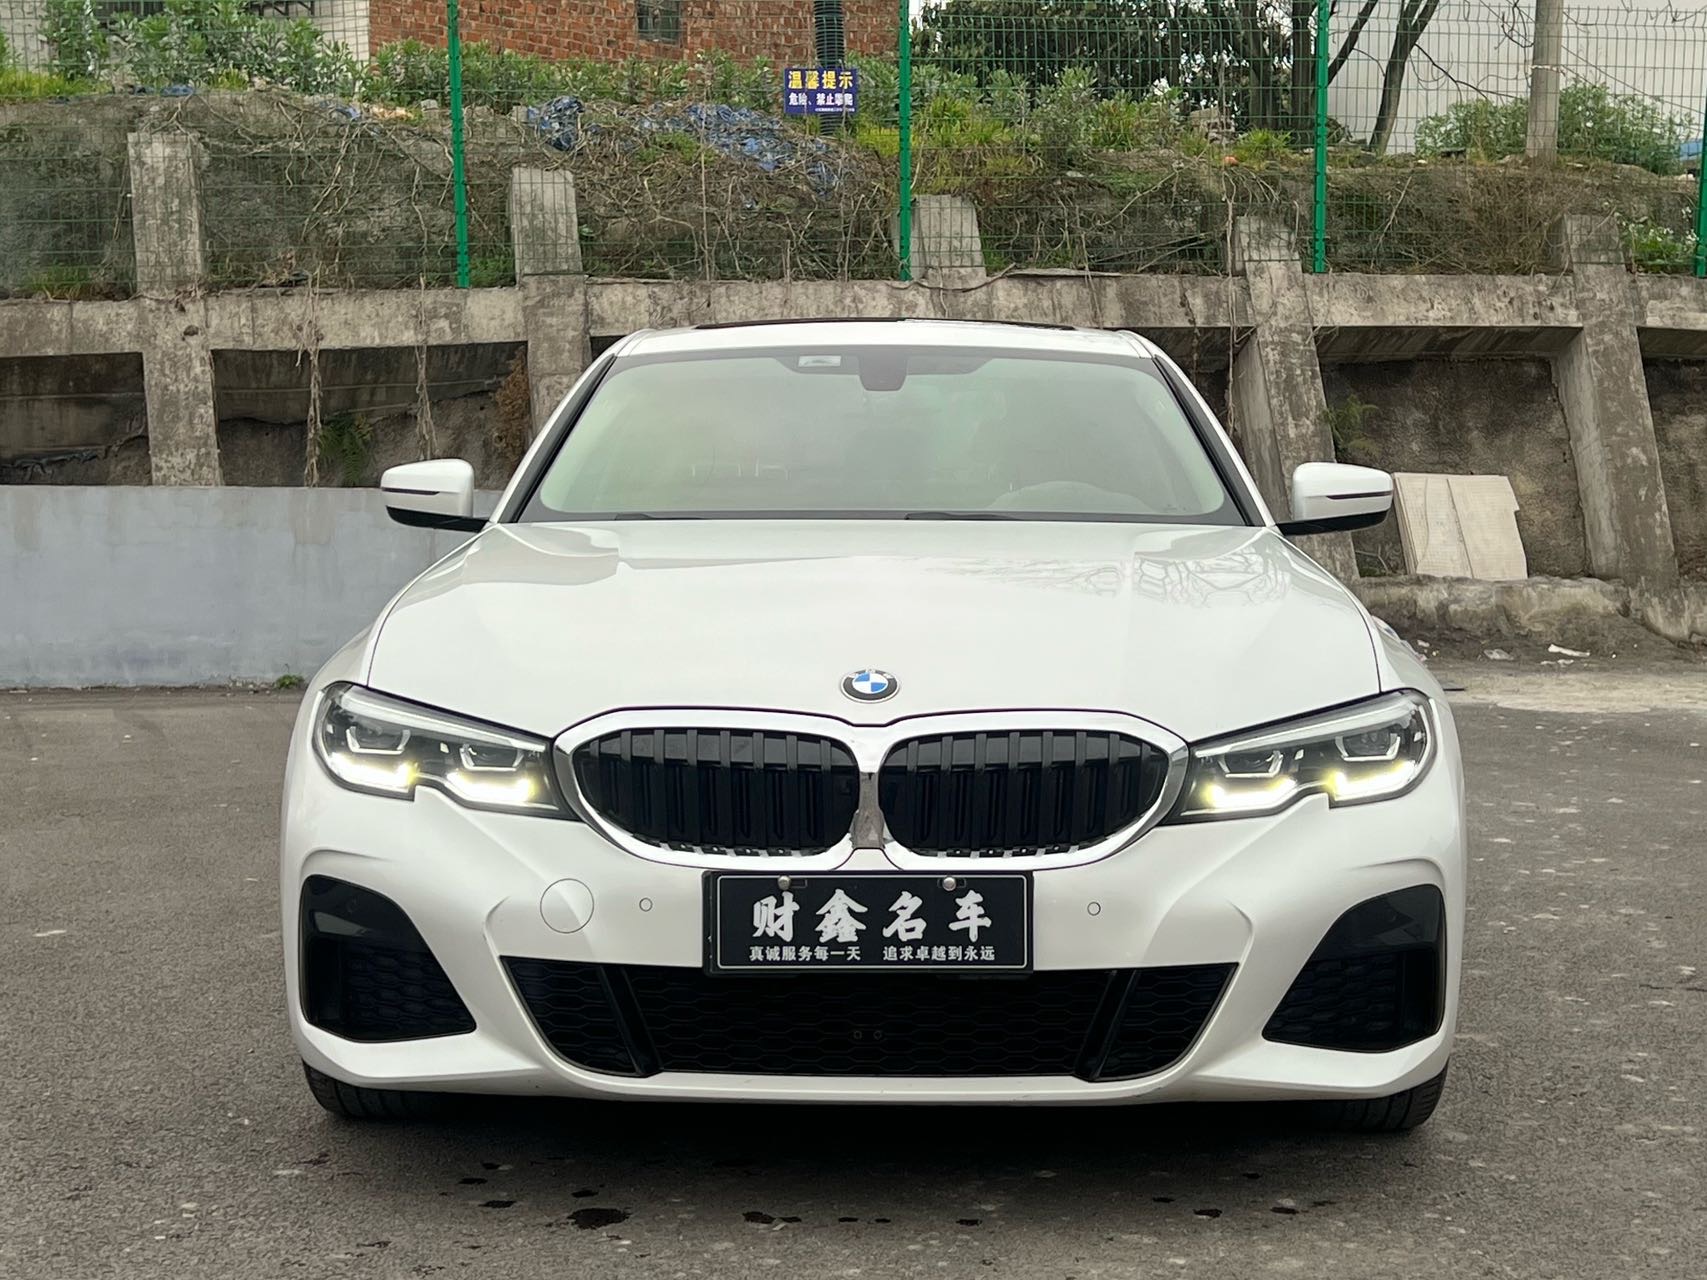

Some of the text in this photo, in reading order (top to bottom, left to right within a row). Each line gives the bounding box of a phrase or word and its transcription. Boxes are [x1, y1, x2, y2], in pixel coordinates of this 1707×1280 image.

[788, 70, 853, 89] 温馨提示
[752, 888, 992, 942] 财鑫名车
[749, 945, 995, 962] 真诚服务每一天 追求卓越到永远
